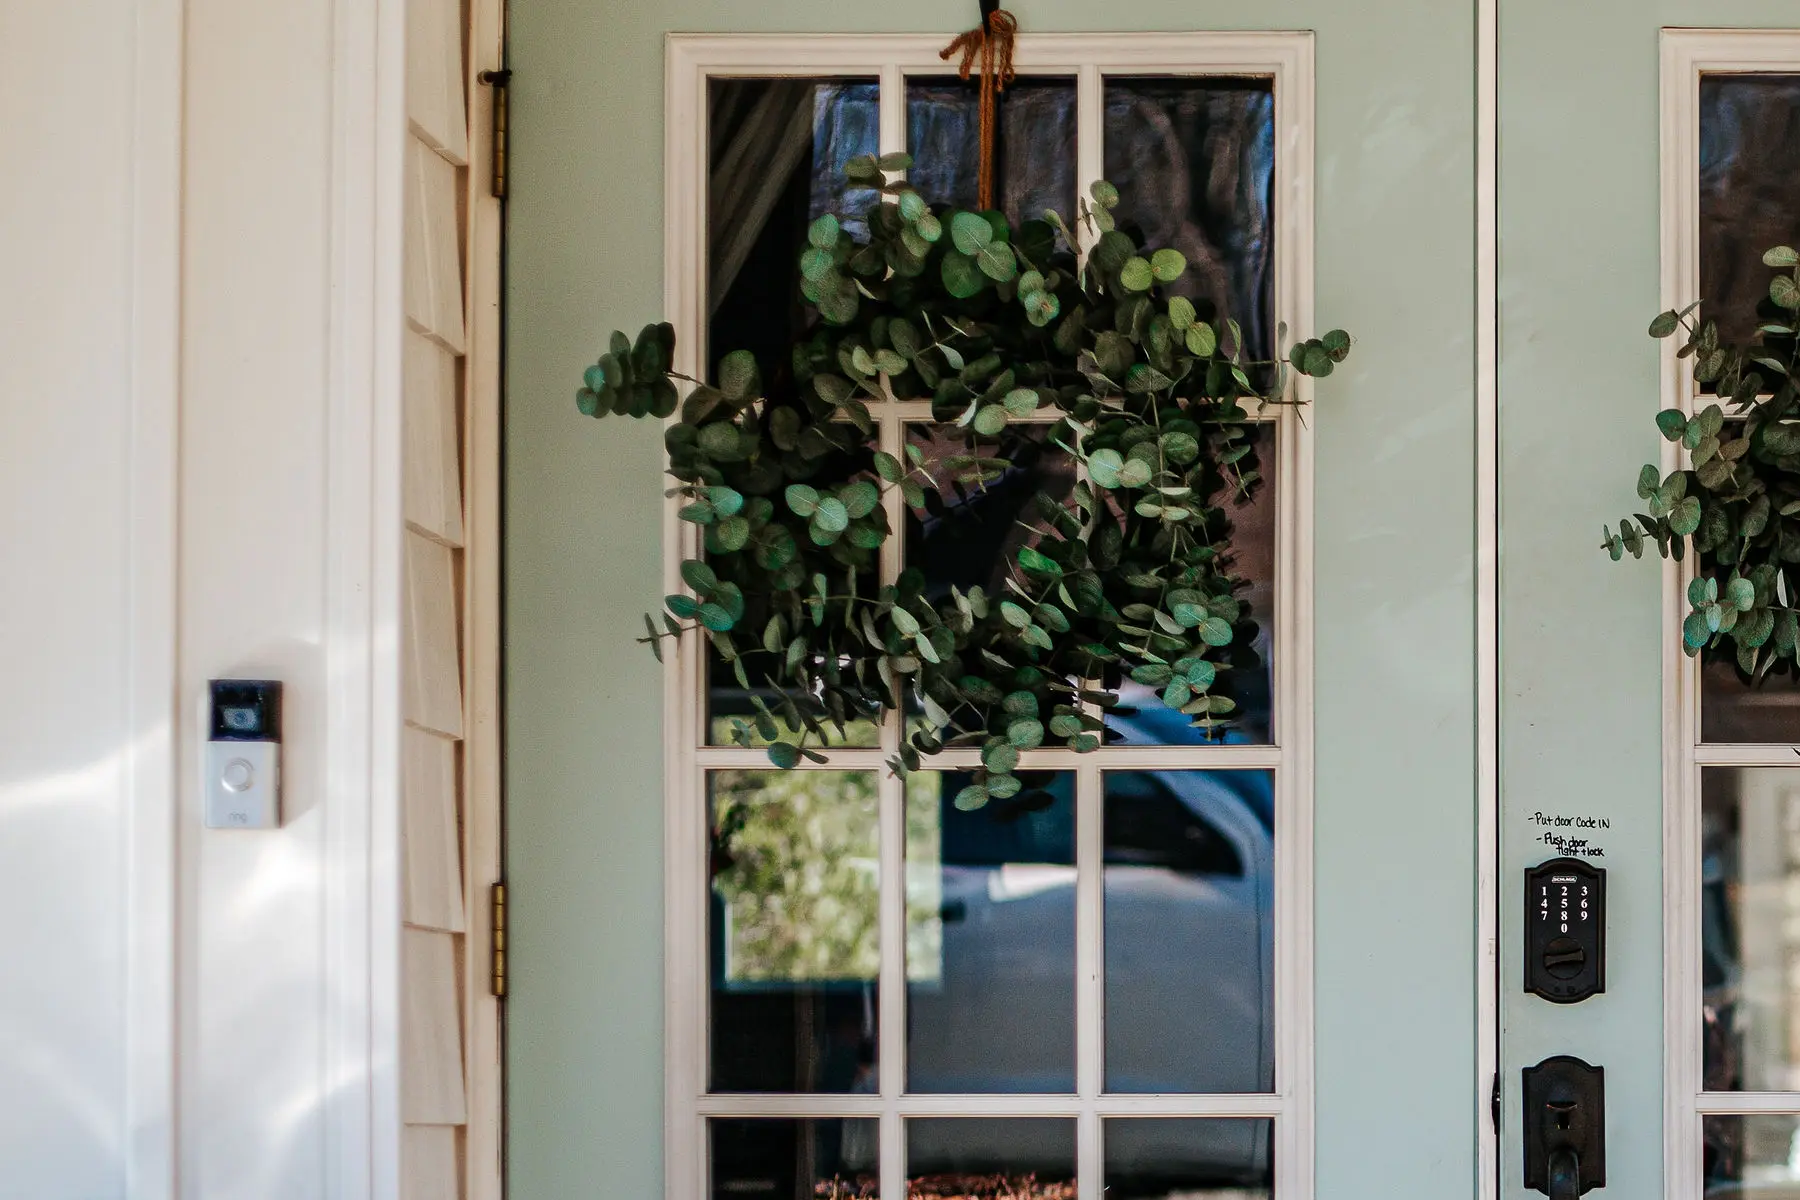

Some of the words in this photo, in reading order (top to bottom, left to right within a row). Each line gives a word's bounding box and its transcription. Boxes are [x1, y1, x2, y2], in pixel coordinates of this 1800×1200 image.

[1535, 812, 1553, 825] Put
[1555, 815, 1574, 826] door
[1599, 818, 1610, 828] IN
[1544, 832, 1567, 846] Push
[1568, 836, 1588, 847] door
[1587, 847, 1604, 856] lock
[1542, 886, 1547, 896] 1
[1561, 886, 1568, 896] 2
[1581, 886, 1588, 896] 3
[1541, 899, 1548, 908] 4
[1561, 899, 1568, 908] 5
[1581, 899, 1588, 908] 6
[1541, 911, 1548, 920] 7
[1561, 911, 1568, 920] 8
[1581, 911, 1588, 920] 9
[1561, 924, 1568, 933] 0
